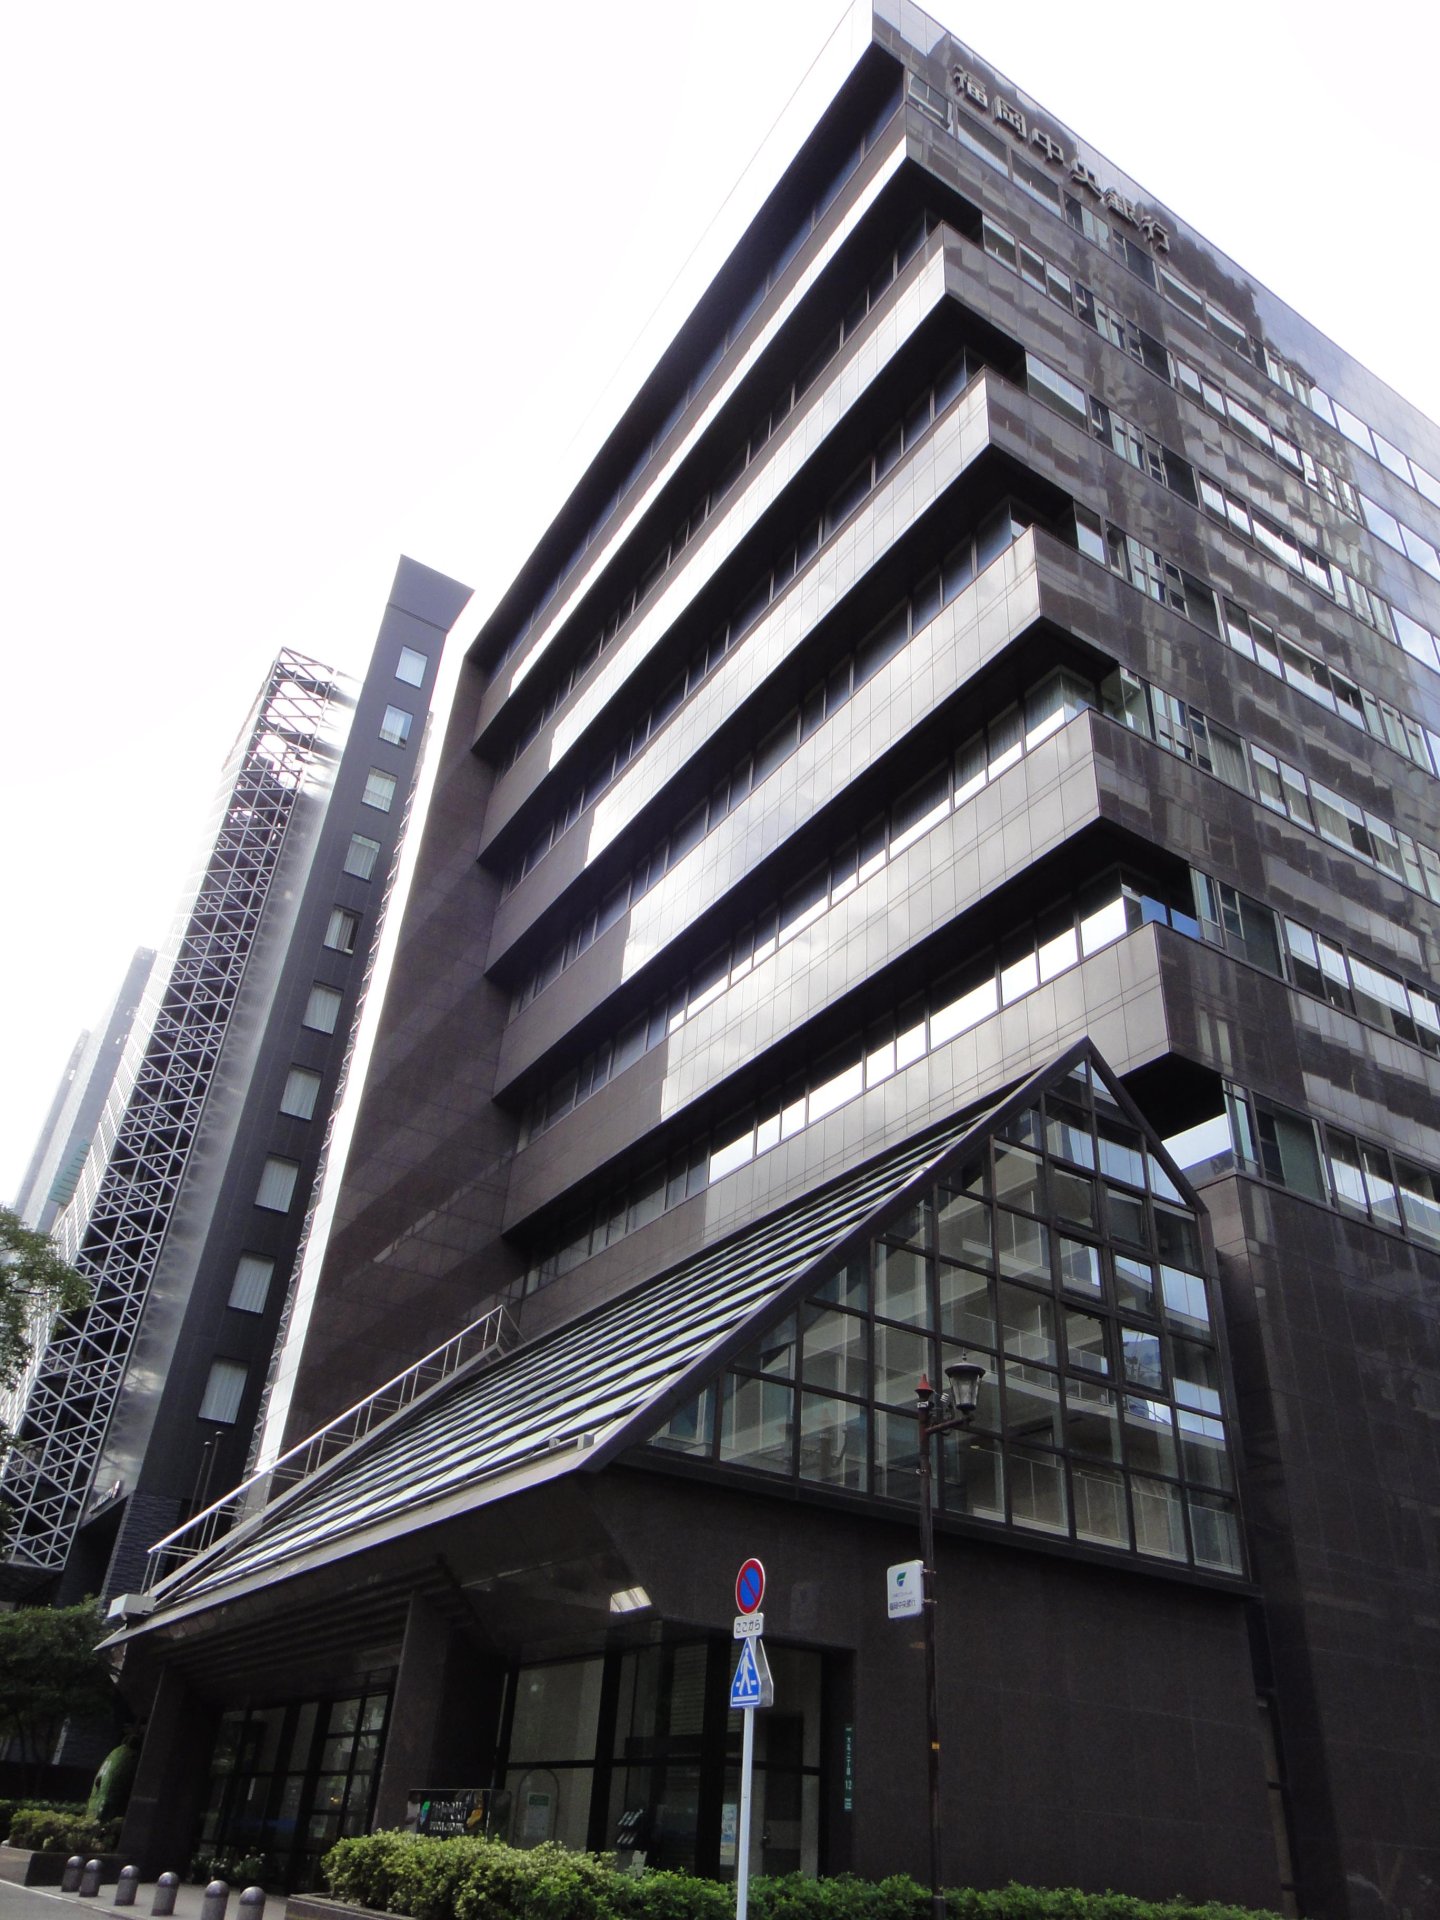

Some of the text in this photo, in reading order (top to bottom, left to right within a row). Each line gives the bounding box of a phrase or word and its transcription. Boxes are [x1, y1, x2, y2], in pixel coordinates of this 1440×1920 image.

[953, 64, 1170, 251] 福岡中央銀行
[735, 1618, 761, 1634] ここから
